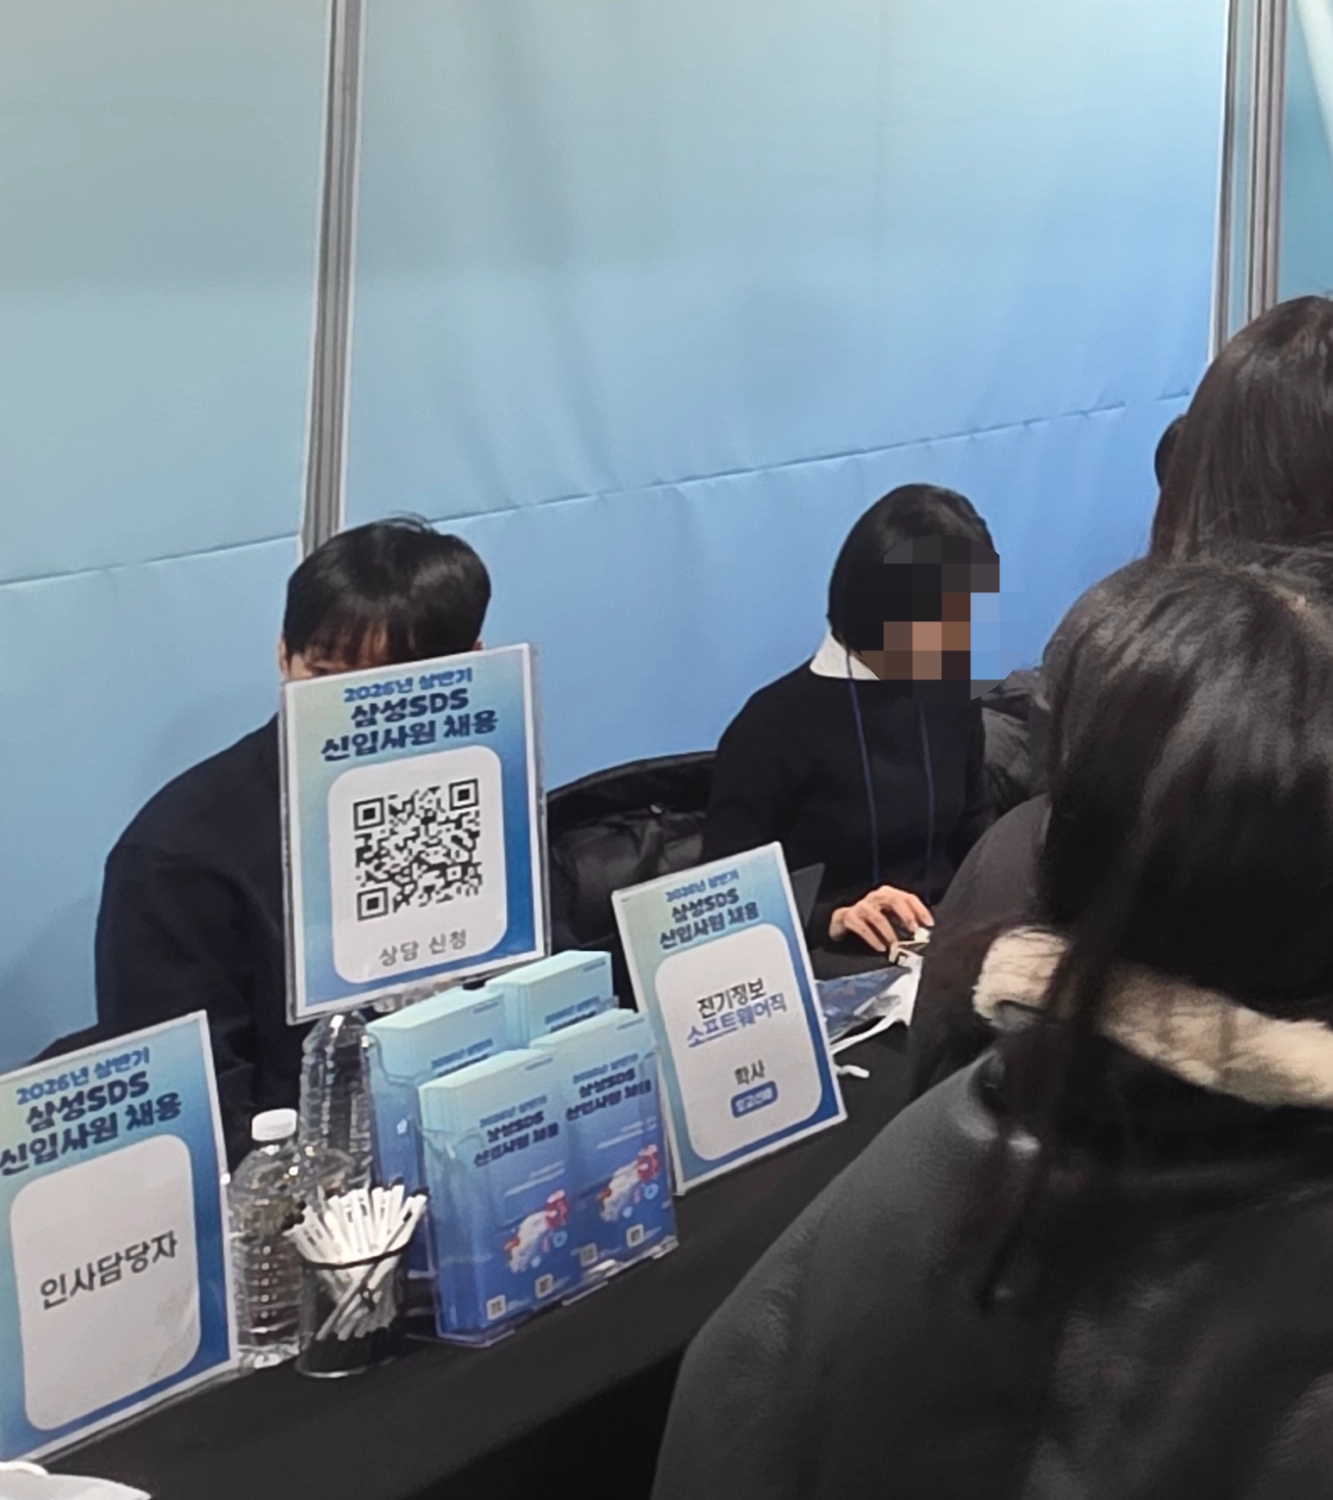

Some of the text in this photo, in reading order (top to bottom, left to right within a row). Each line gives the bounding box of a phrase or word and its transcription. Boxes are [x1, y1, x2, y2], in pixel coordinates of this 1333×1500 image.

[344, 667, 473, 702] 2026년 상반기
[351, 688, 469, 729] 삼성SDS
[321, 710, 498, 762] 신입사원 채용
[672, 888, 739, 924] 삼성SDS
[379, 929, 467, 967] 상담 신청
[697, 977, 767, 1019] 전기정보
[16, 1047, 150, 1104] 2026년 상반기
[26, 1071, 150, 1133] 삼성SDS
[0, 1092, 182, 1176] 신입사원 채용
[40, 1230, 178, 1310] 인사담당자
